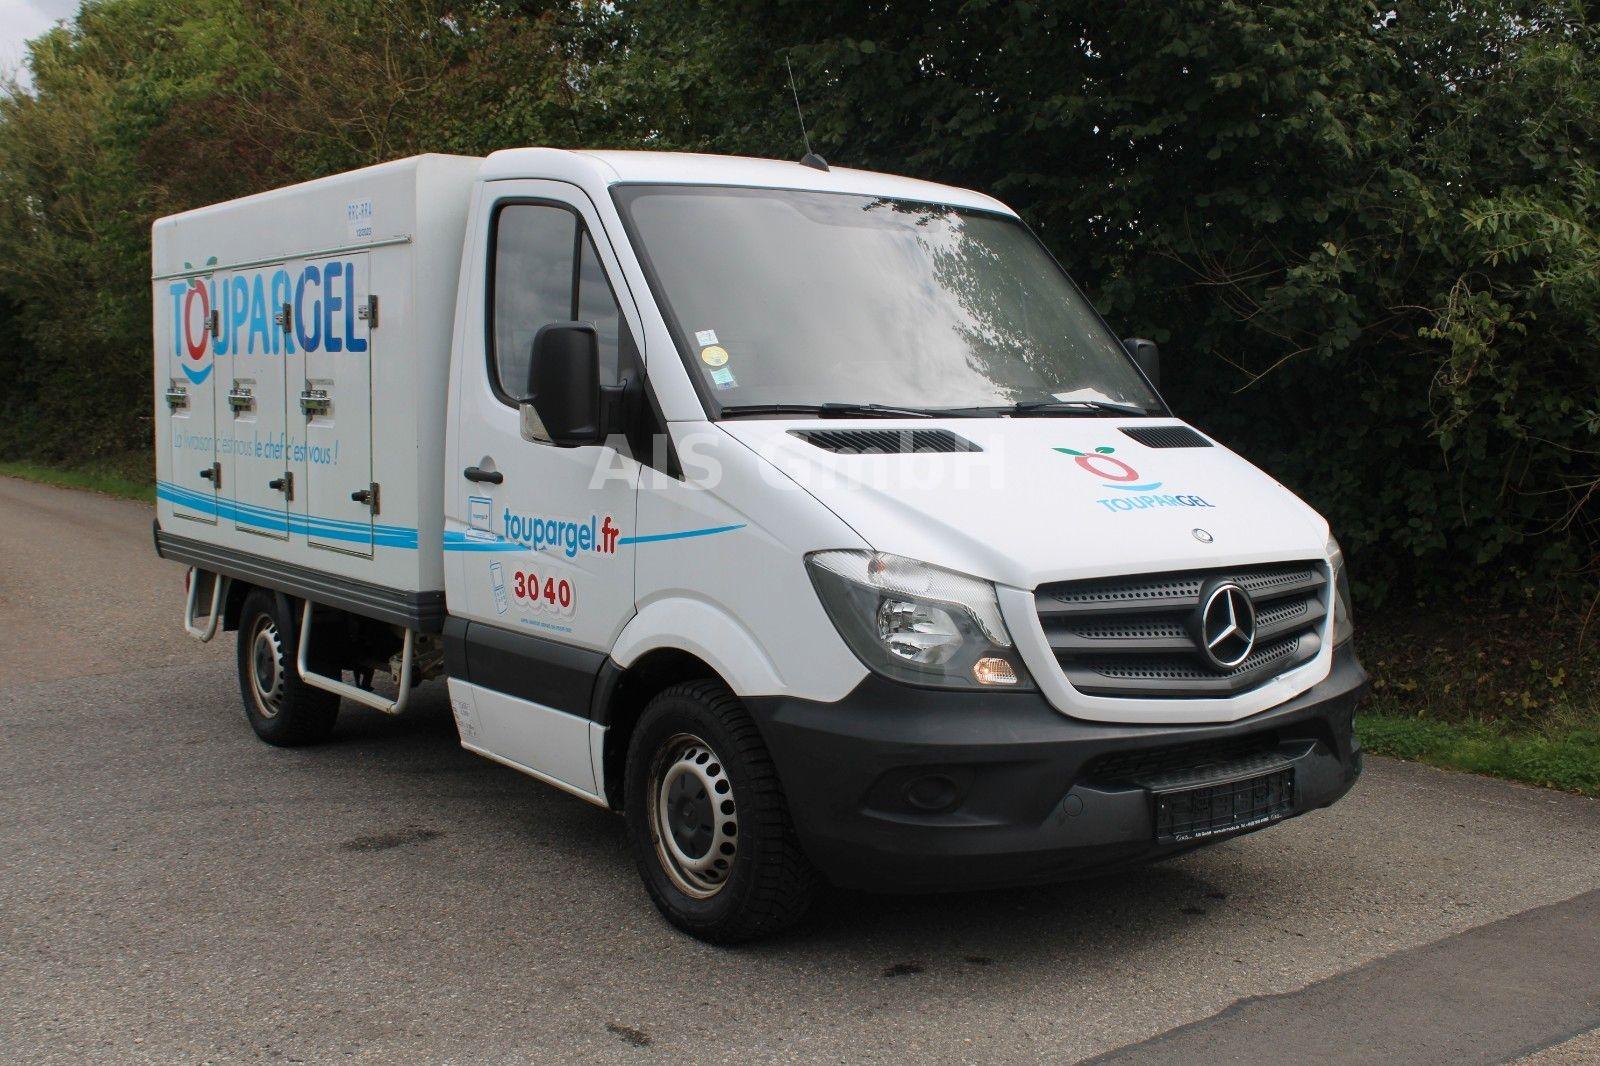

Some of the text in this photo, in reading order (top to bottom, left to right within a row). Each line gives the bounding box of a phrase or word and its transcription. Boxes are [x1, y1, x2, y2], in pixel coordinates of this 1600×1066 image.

[170, 261, 368, 360] TOUPARGEL
[174, 432, 183, 449] La
[255, 431, 262, 458] le
[264, 432, 285, 460] chef
[286, 436, 307, 462] c'est
[309, 445, 331, 465] vous
[1097, 495, 1216, 512] TOUPARGEL
[504, 507, 619, 558] toupargel.fr
